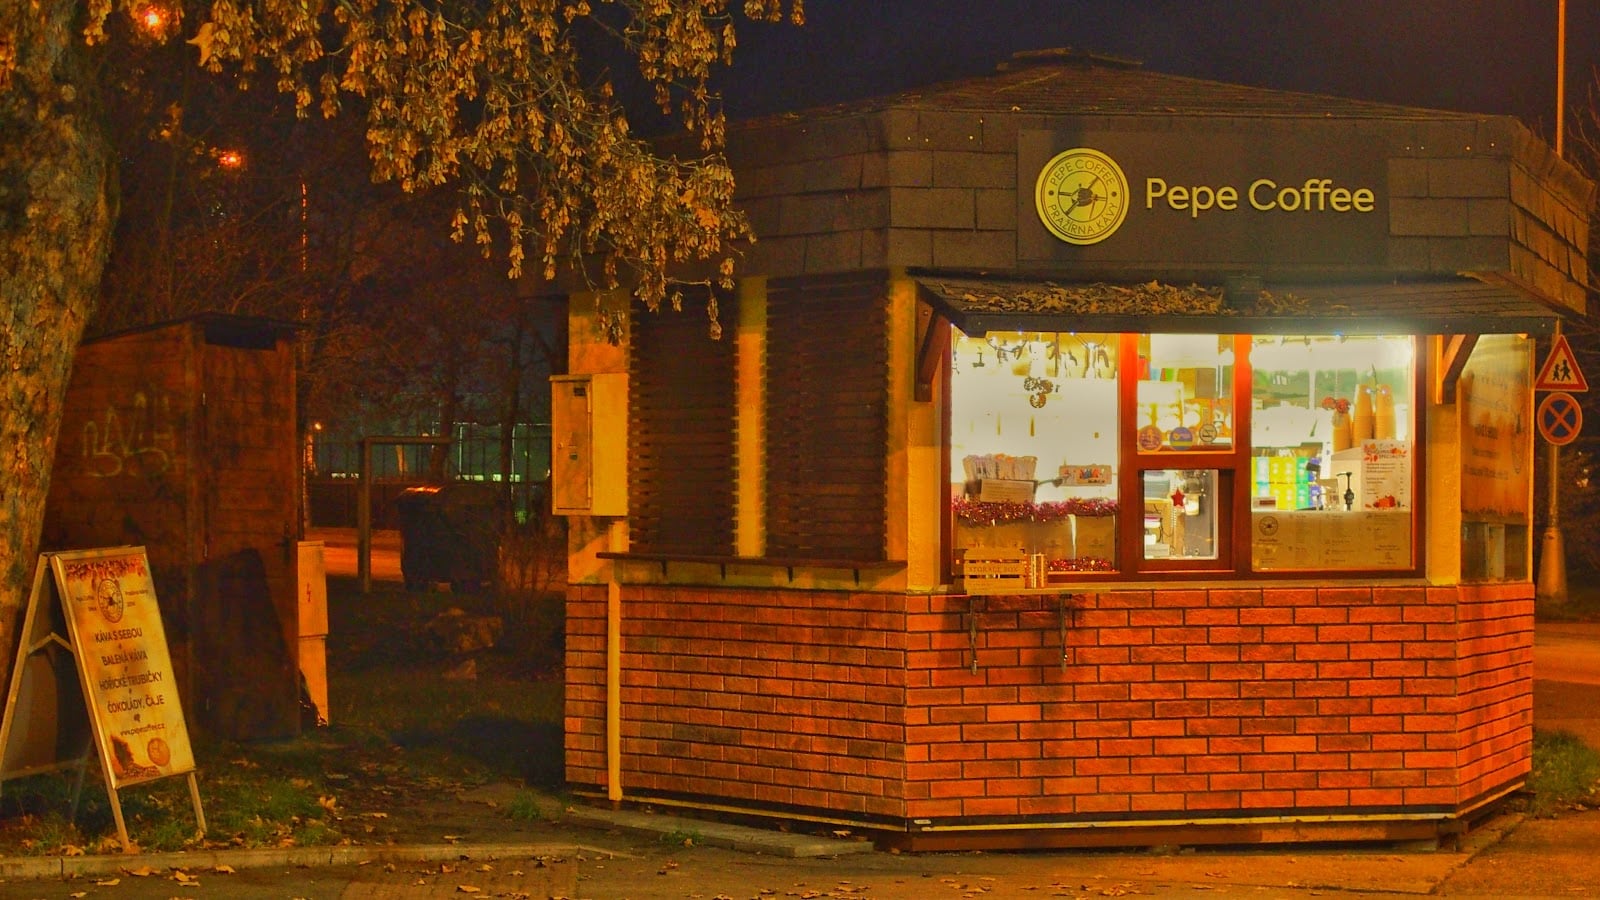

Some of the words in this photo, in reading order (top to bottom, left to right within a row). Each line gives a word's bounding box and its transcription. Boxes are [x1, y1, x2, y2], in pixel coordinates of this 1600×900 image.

[1050, 162, 1073, 186] PEPE
[1075, 159, 1115, 185] COFFEE
[1146, 177, 1238, 218] Pepe
[1248, 178, 1375, 212] Coffee
[1096, 202, 1118, 228] KÁVY
[95, 630, 112, 643] KÁVA
[112, 631, 117, 641] S
[118, 628, 142, 640] SEBOU
[101, 651, 129, 666] BALENÁ
[129, 648, 148, 662] KÁVA
[127, 670, 162, 686] TRUBIČKY
